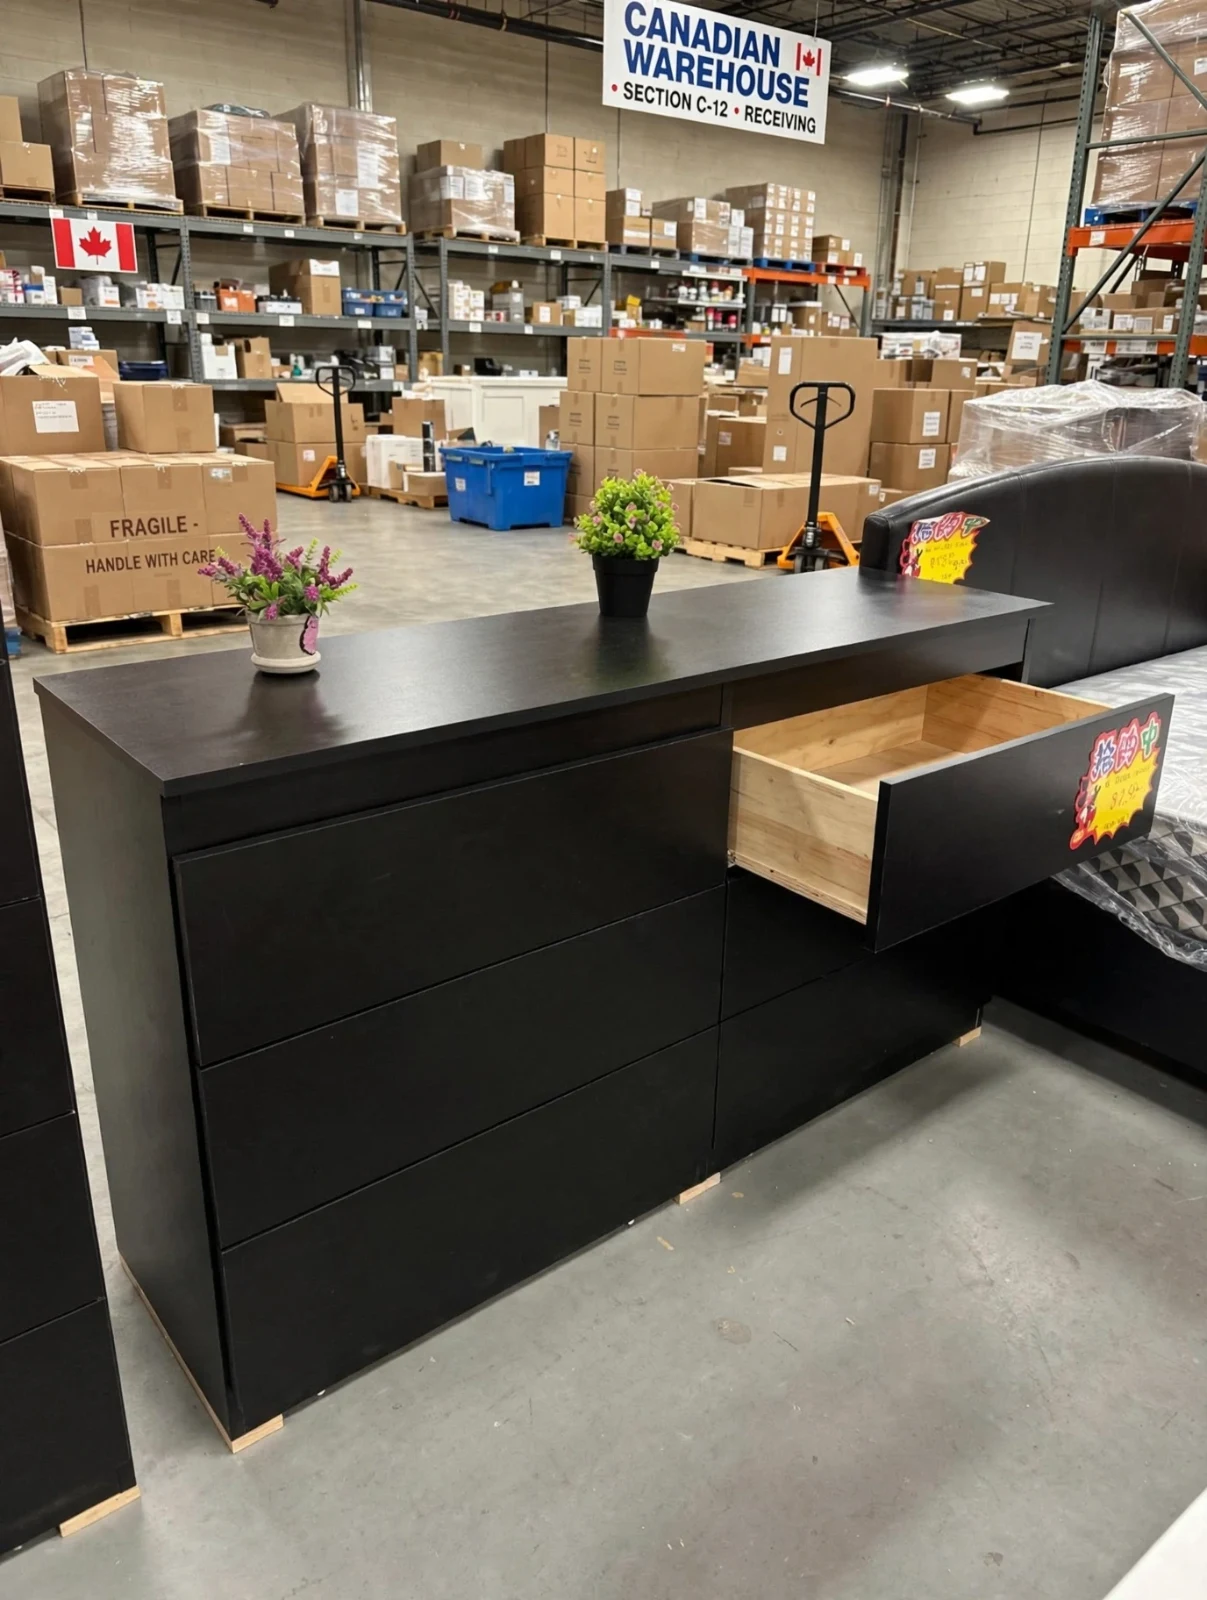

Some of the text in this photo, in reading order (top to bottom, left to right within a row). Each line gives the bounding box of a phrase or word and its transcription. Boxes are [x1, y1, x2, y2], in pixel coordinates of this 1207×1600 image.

[624, 1, 781, 68] CANADIAN
[623, 38, 810, 108] WAREHOUSE
[623, 81, 816, 134] SECTION C-12 RECEIVING
[110, 515, 187, 538] FRAGILE
[86, 549, 216, 574] HANDLE WITH CARE
